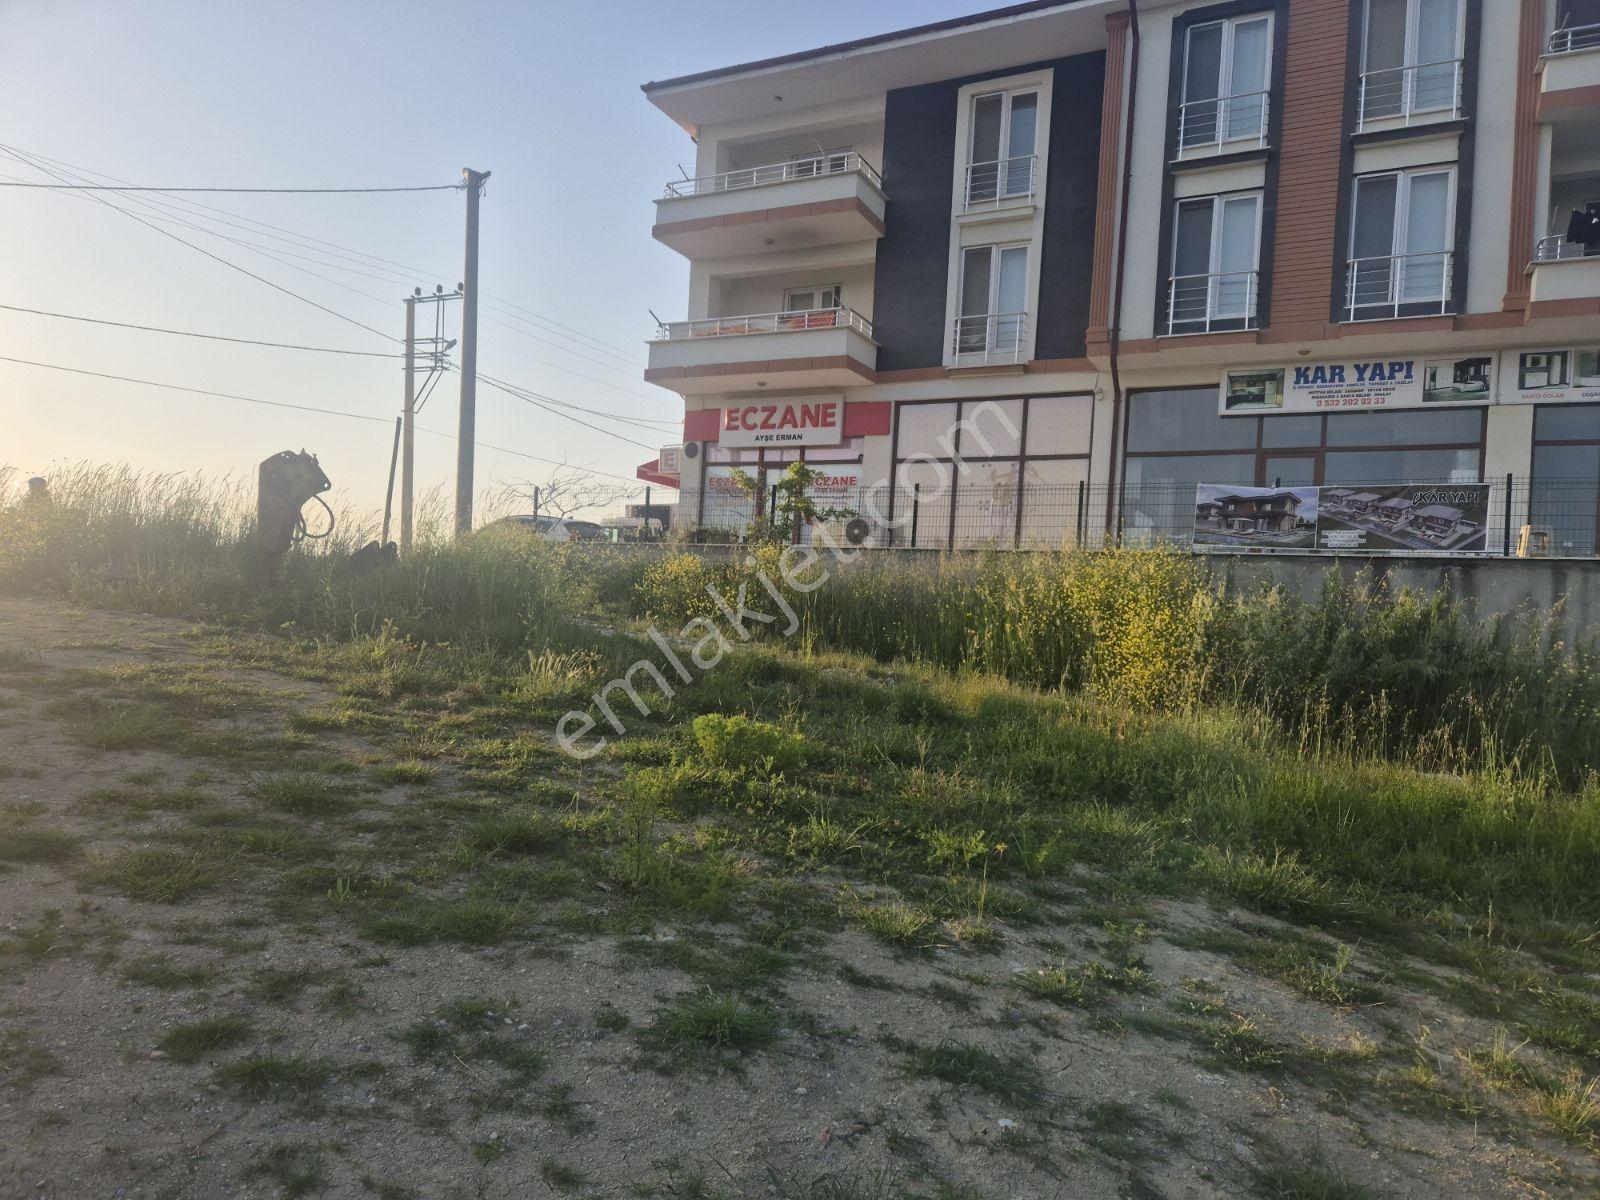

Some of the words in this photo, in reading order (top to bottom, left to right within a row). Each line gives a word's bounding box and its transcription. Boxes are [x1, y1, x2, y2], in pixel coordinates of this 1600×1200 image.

[1294, 365, 1345, 385] KAR
[1353, 361, 1414, 382] YAPI
[1324, 399, 1340, 407] 532
[1342, 398, 1359, 406] 202
[725, 402, 837, 431] ECZANE
[754, 434, 774, 443] AYŞE
[775, 433, 803, 442] ERMAN
[1418, 490, 1448, 503] KAR
[1450, 491, 1480, 503] YAPI
